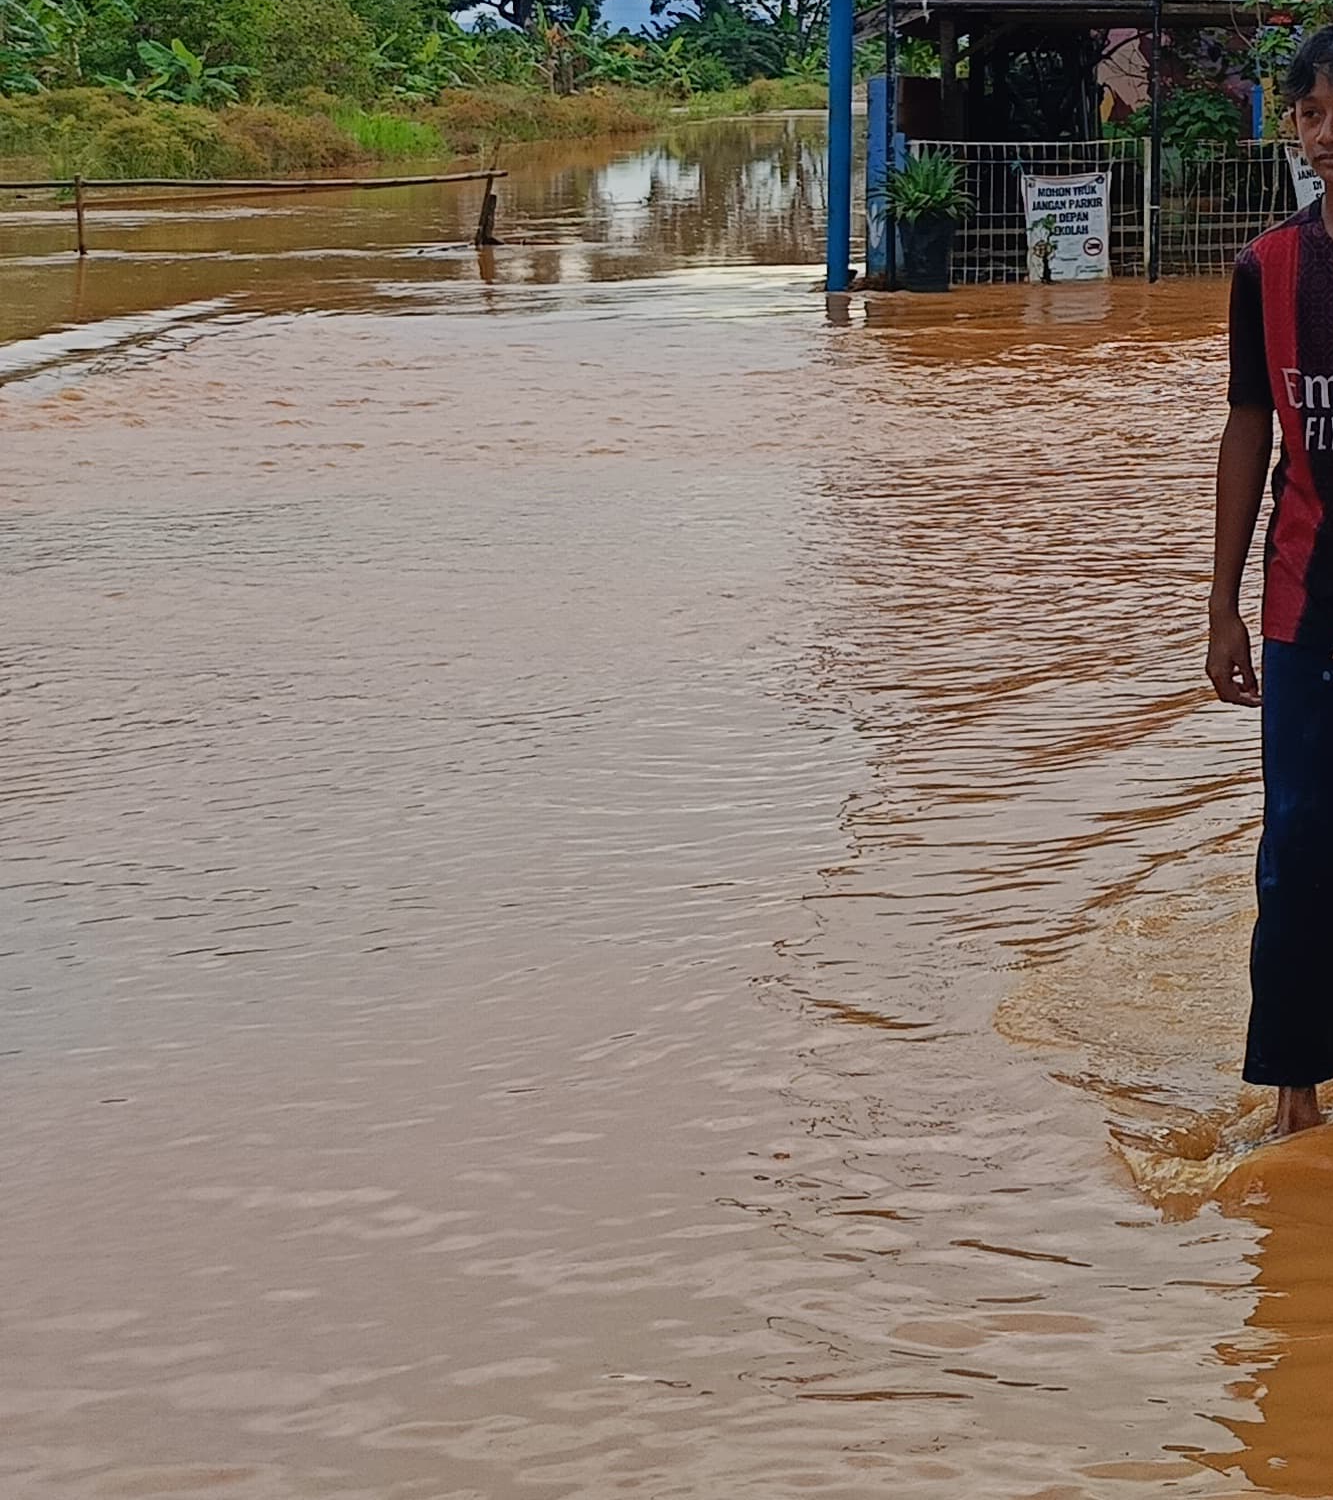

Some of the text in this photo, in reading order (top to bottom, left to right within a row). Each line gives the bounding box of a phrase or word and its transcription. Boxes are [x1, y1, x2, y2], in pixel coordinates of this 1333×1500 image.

[1038, 185, 1097, 197] MOHON TRUK
[1032, 198, 1103, 211] JANGAN PARKIR
[1059, 212, 1089, 223] DEPAN
[1053, 225, 1089, 236] EKOLAH
